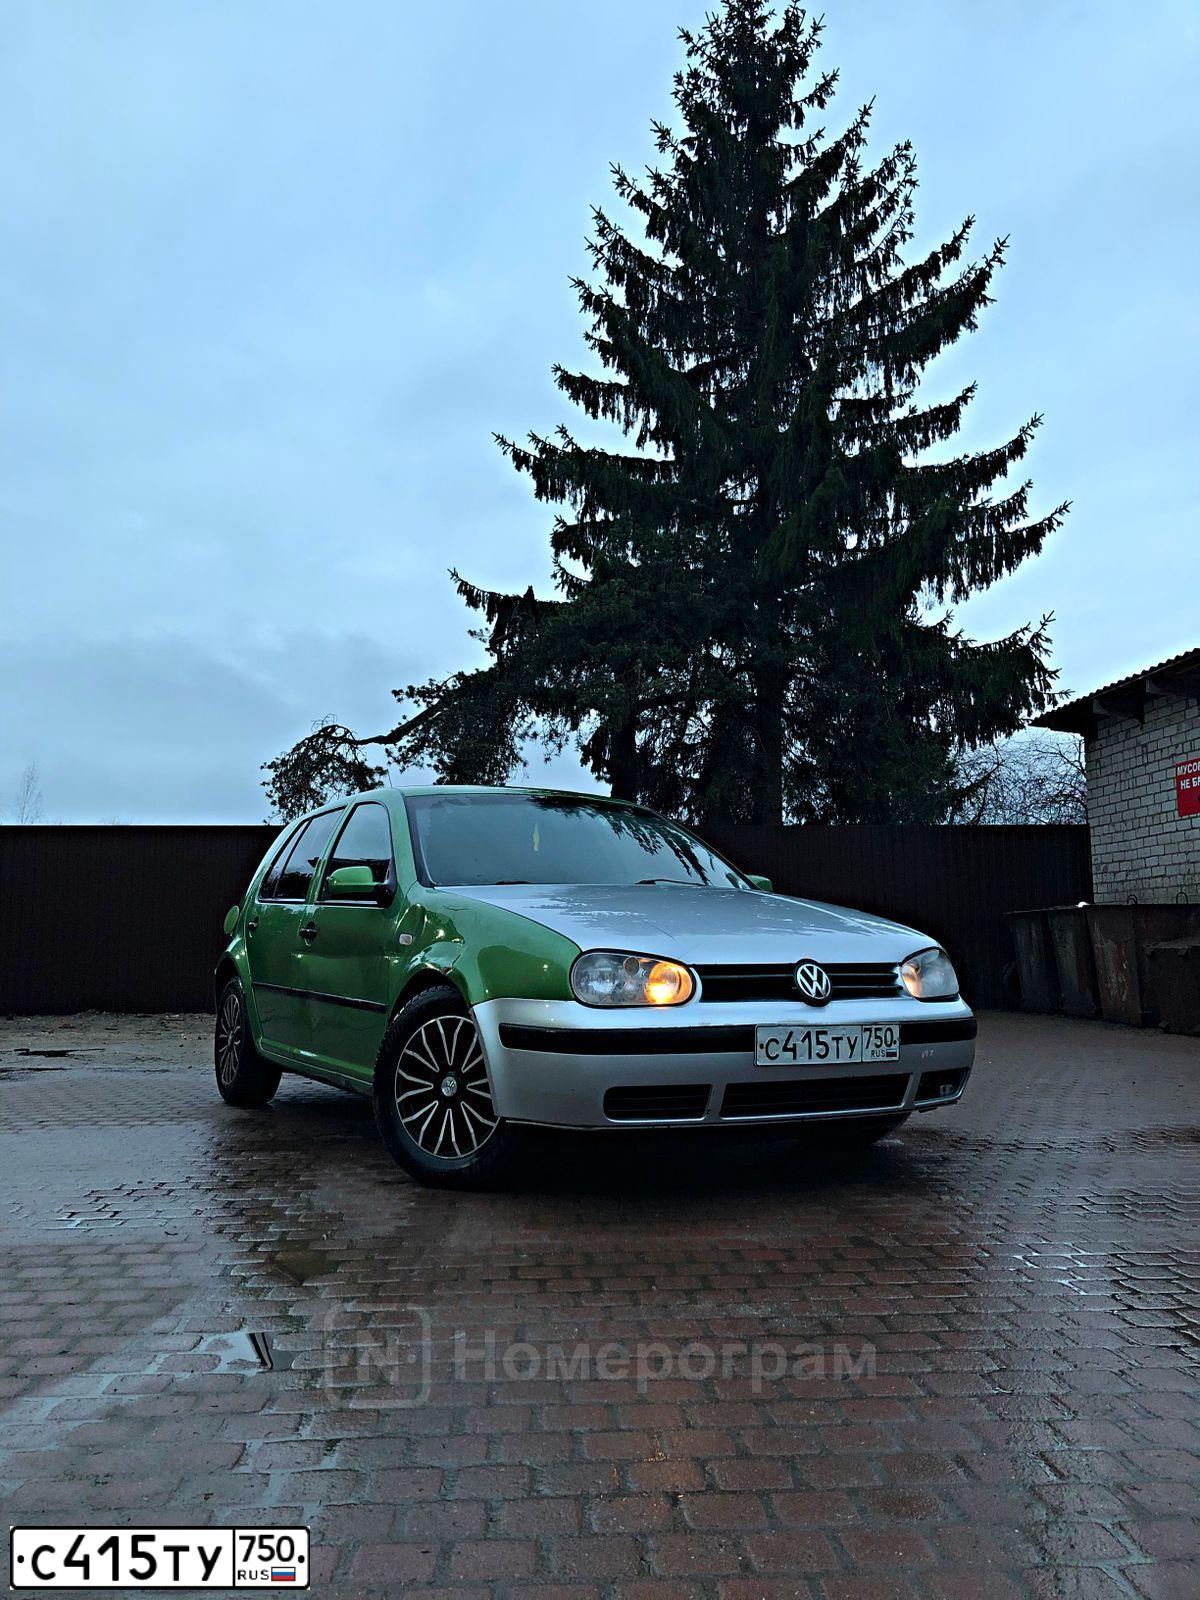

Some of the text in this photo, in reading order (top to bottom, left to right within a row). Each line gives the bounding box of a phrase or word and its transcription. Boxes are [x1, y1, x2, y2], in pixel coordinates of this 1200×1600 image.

[1180, 779, 1191, 790] НЕ
[765, 1027, 894, 1060] С415ТУ 750
[871, 1049, 886, 1058] RUS
